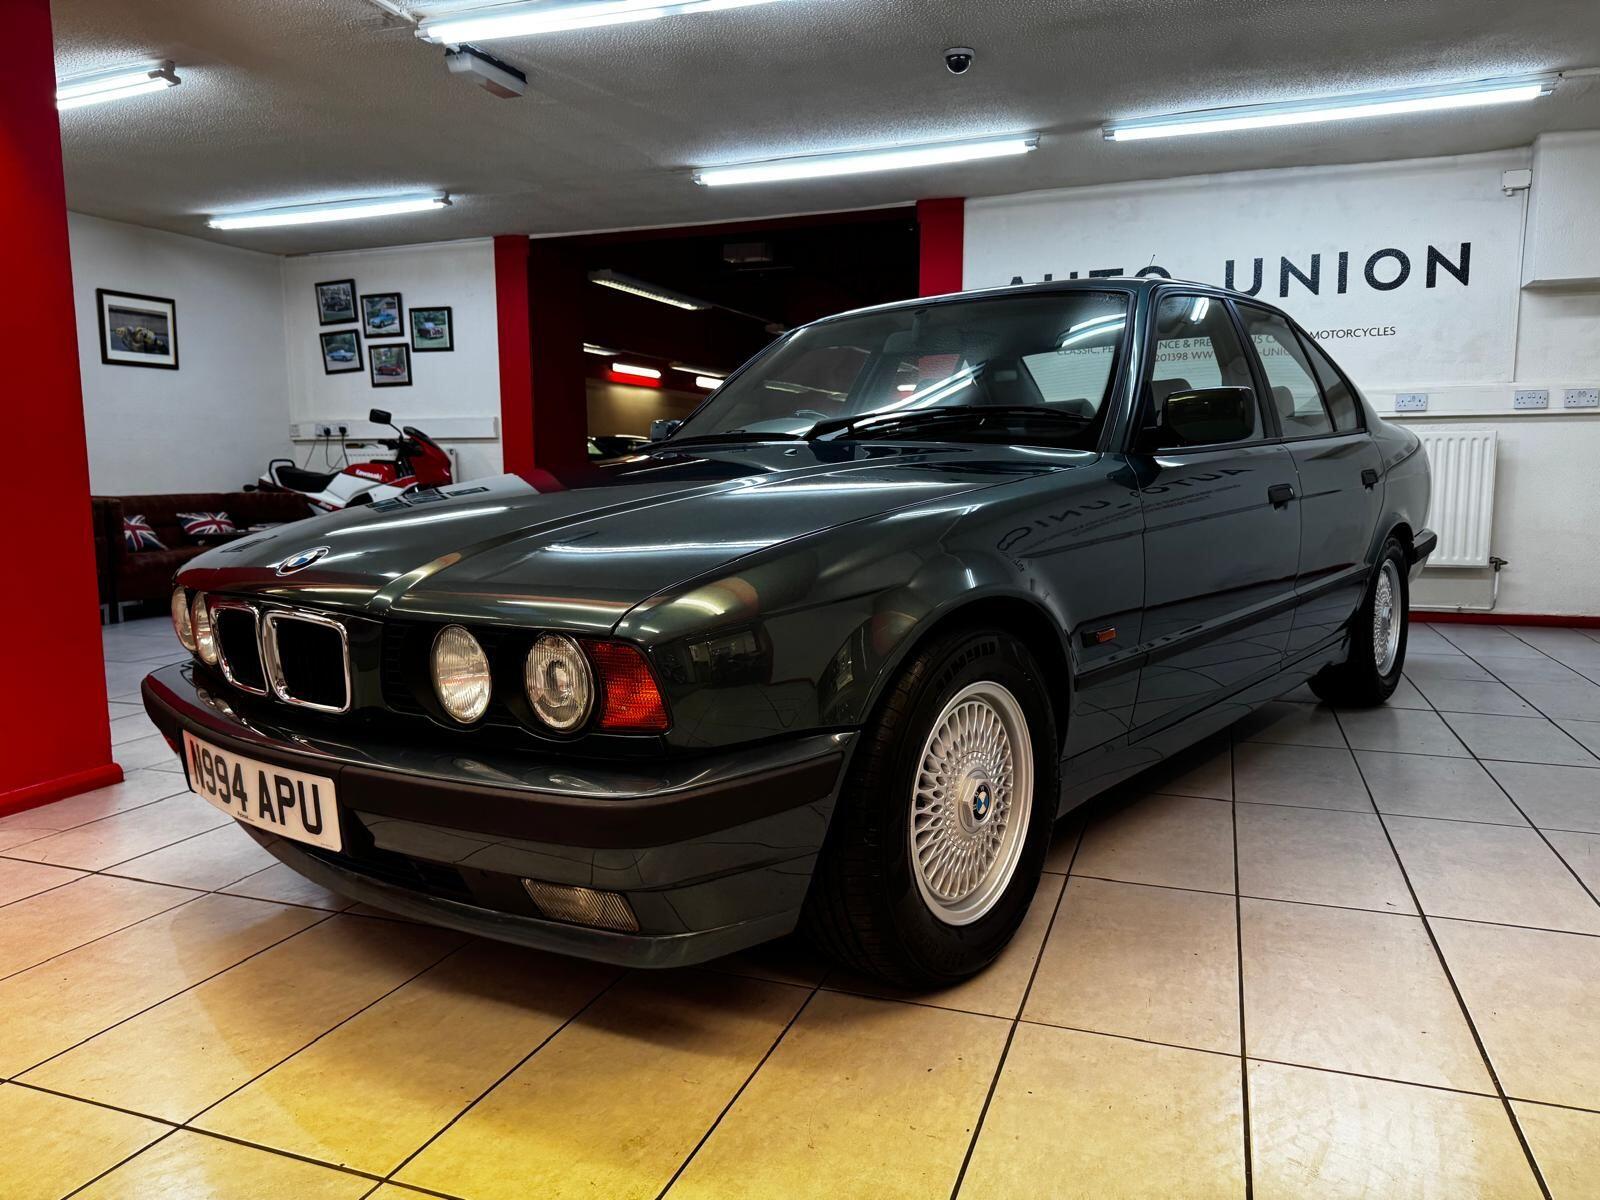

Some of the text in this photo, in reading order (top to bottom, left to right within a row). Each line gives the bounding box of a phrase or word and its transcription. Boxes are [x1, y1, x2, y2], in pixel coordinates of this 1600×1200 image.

[1225, 242, 1471, 297] UNION
[1194, 338, 1212, 348] PRE
[1309, 326, 1396, 340] MOTORCYCLES
[190, 739, 323, 836] N994 APU
